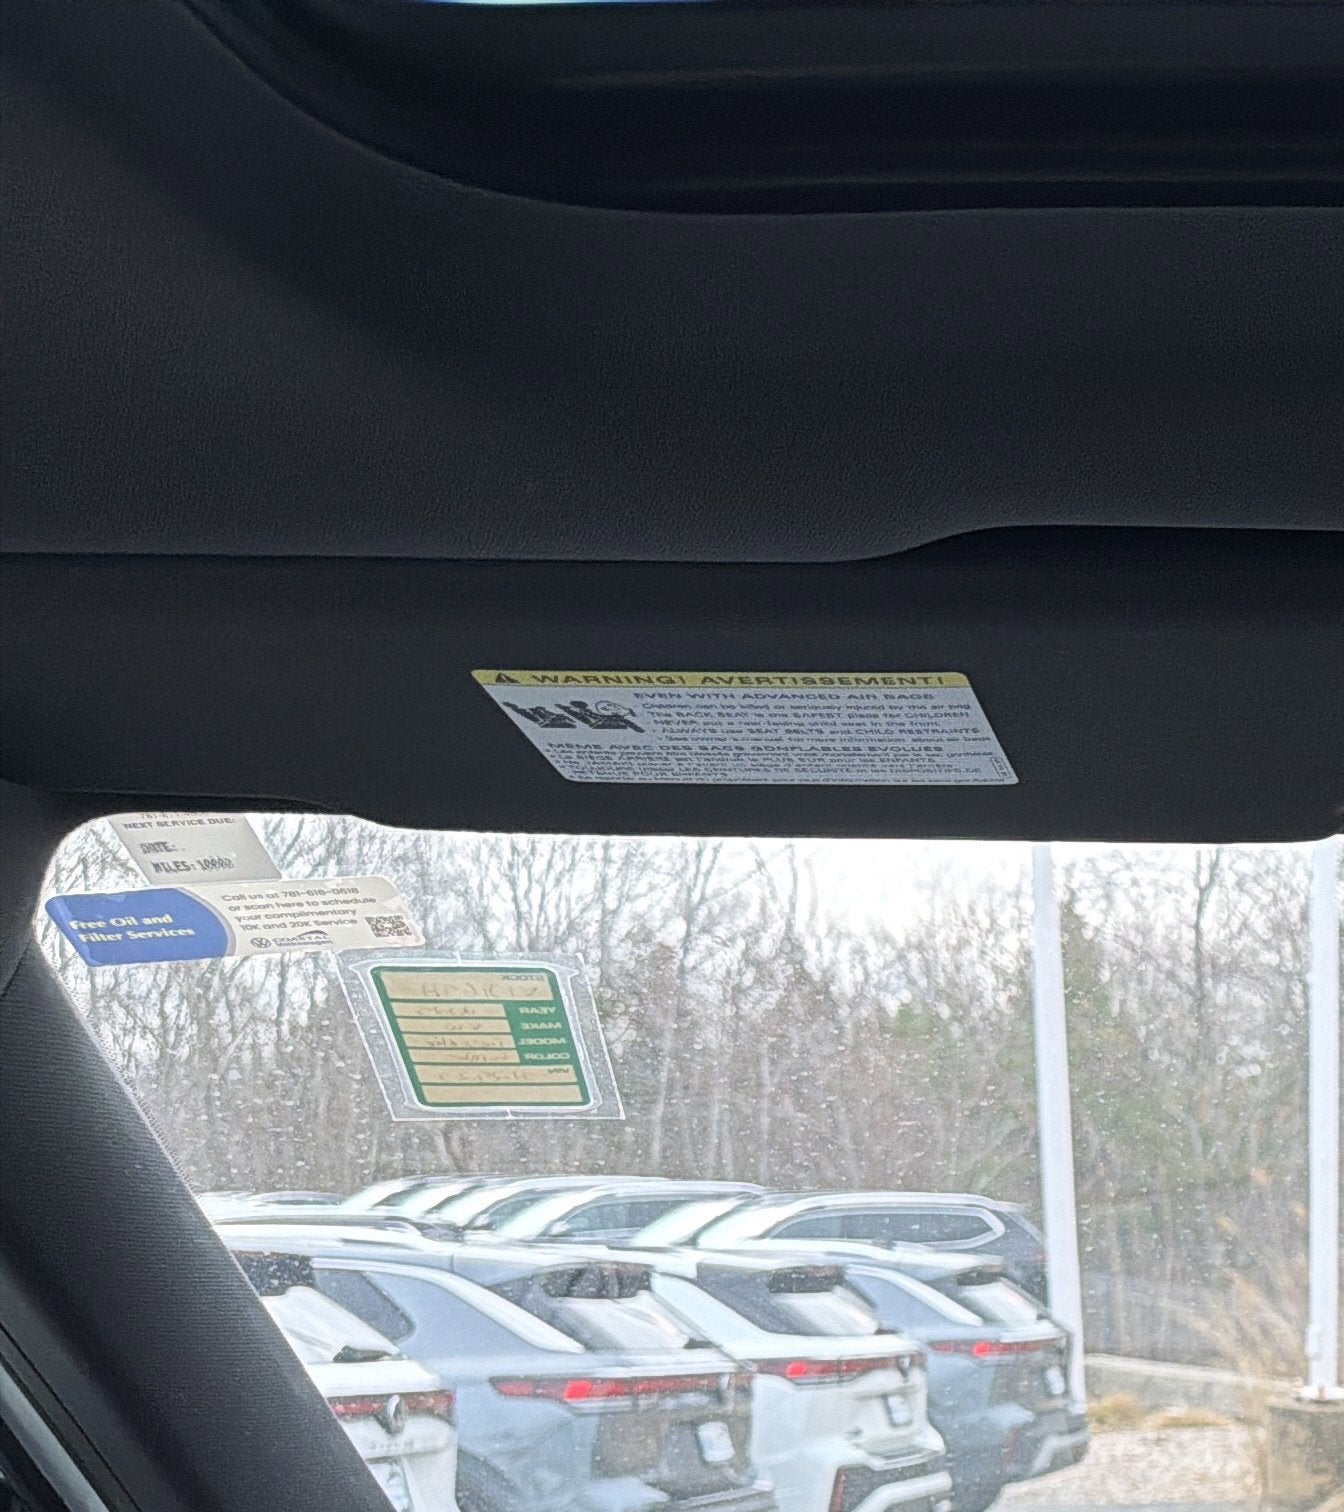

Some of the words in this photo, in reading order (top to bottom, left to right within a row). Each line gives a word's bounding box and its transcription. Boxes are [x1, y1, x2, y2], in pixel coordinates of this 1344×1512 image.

[531, 674, 685, 685] WARNING!
[701, 676, 945, 687] AVERTISSEMENT!
[123, 822, 152, 830] NEXT
[156, 819, 207, 828] SERVICE
[208, 818, 236, 826] DUE:
[221, 893, 247, 902] Call
[229, 904, 242, 912] or
[244, 902, 275, 911] scan
[276, 900, 304, 910] here
[305, 900, 319, 908] to
[321, 897, 377, 907] schedule
[69, 919, 106, 930] Free
[109, 916, 138, 927] Oil
[142, 914, 173, 926] and
[234, 915, 262, 923] your
[264, 908, 357, 921] complimentary
[239, 923, 261, 931] 10K
[263, 922, 287, 930] and
[290, 920, 311, 929] 20K
[314, 918, 358, 928] Service
[79, 933, 123, 943] Filter
[127, 928, 196, 940] Services
